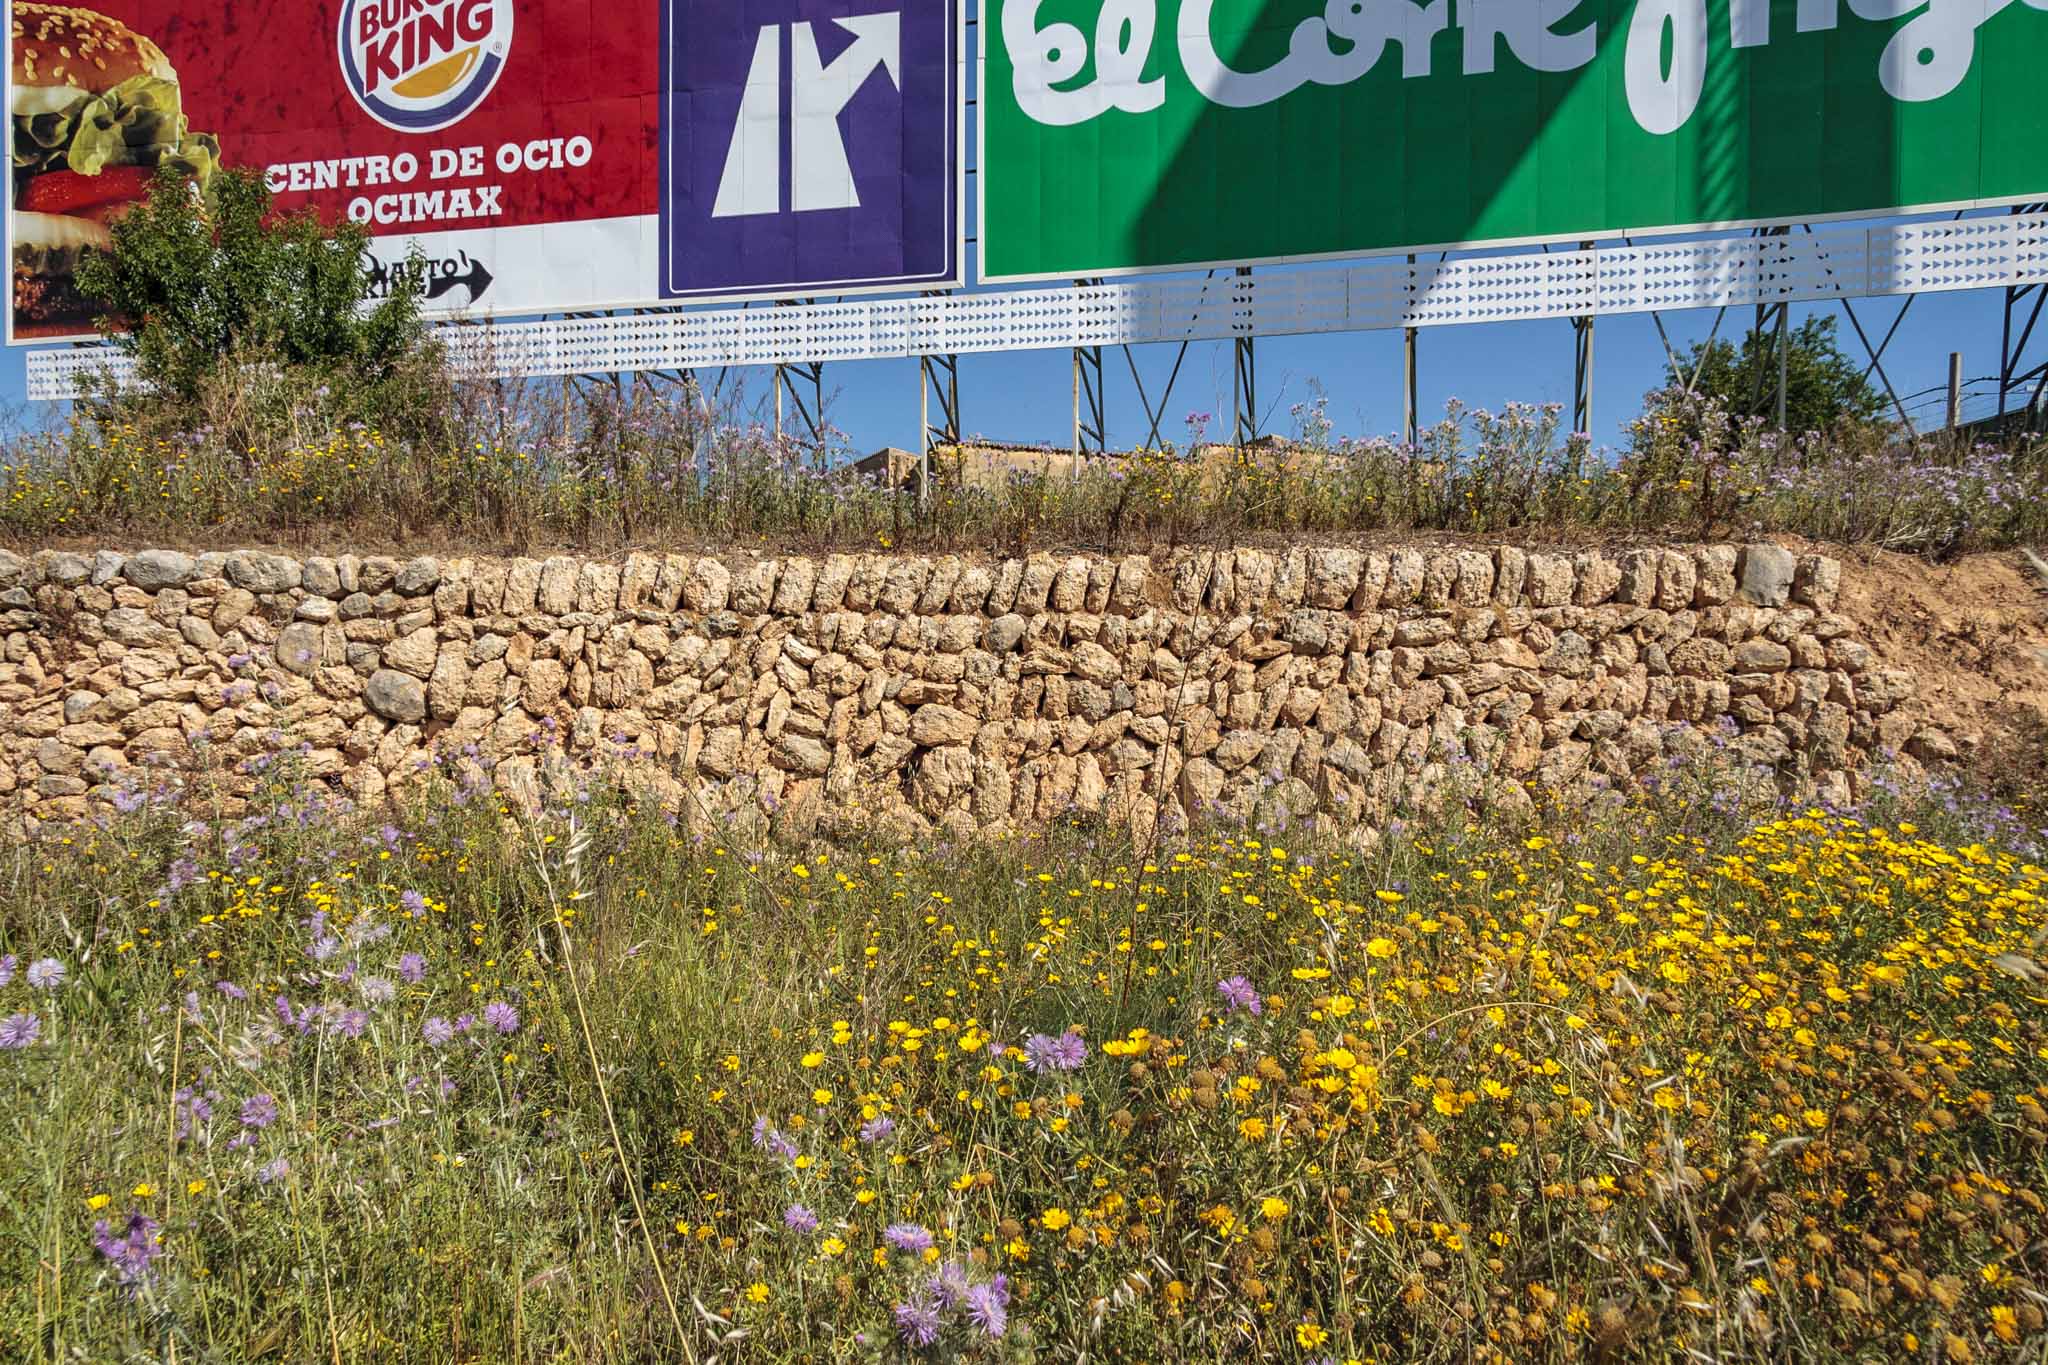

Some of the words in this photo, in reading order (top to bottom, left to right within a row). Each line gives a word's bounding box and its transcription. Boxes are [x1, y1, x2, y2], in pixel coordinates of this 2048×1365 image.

[366, 0, 493, 95] KING
[267, 152, 418, 193] CENTRO
[430, 146, 484, 179] DE
[496, 135, 592, 173] OCIO
[347, 185, 502, 225] OCIMAX
[388, 258, 458, 280] ATO
